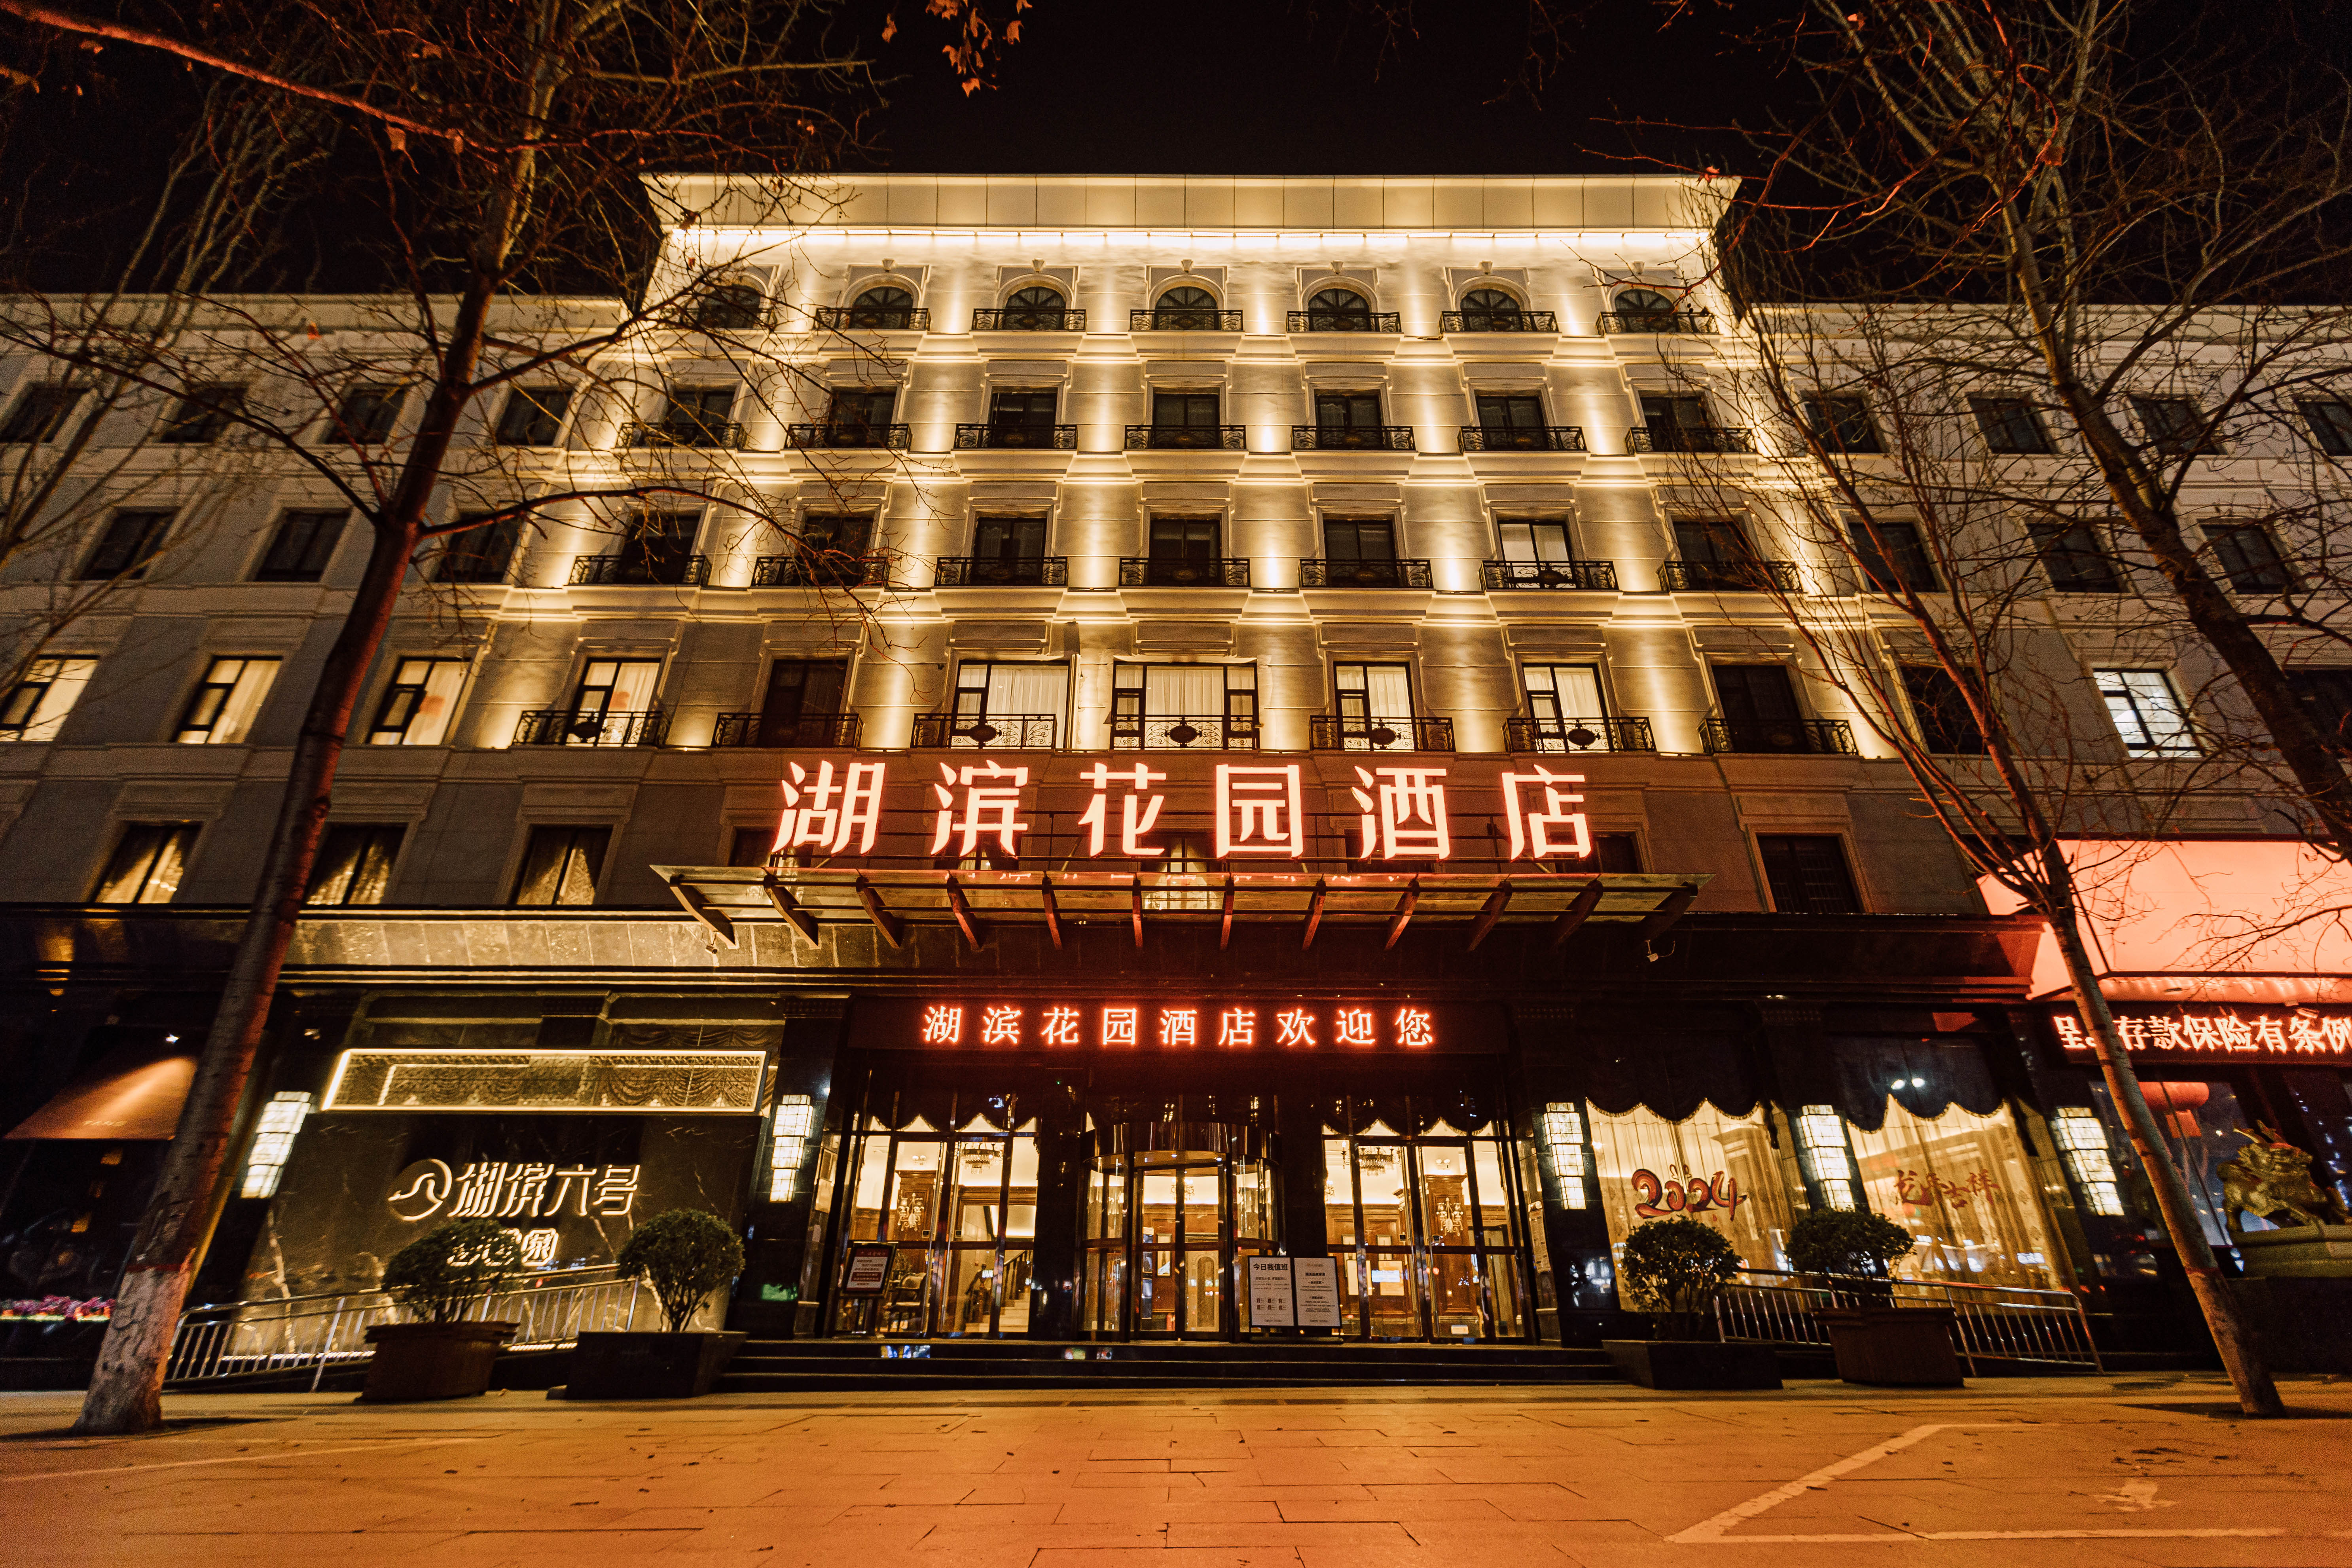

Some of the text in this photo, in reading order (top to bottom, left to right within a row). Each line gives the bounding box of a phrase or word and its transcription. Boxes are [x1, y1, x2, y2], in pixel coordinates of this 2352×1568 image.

[772, 760, 1591, 861] 湖滨花园酒店
[923, 1005, 1434, 1046] 湖滨花园酒店欢迎您
[448, 1162, 640, 1217] 湖滨六号
[1632, 1168, 1747, 1221] 2024
